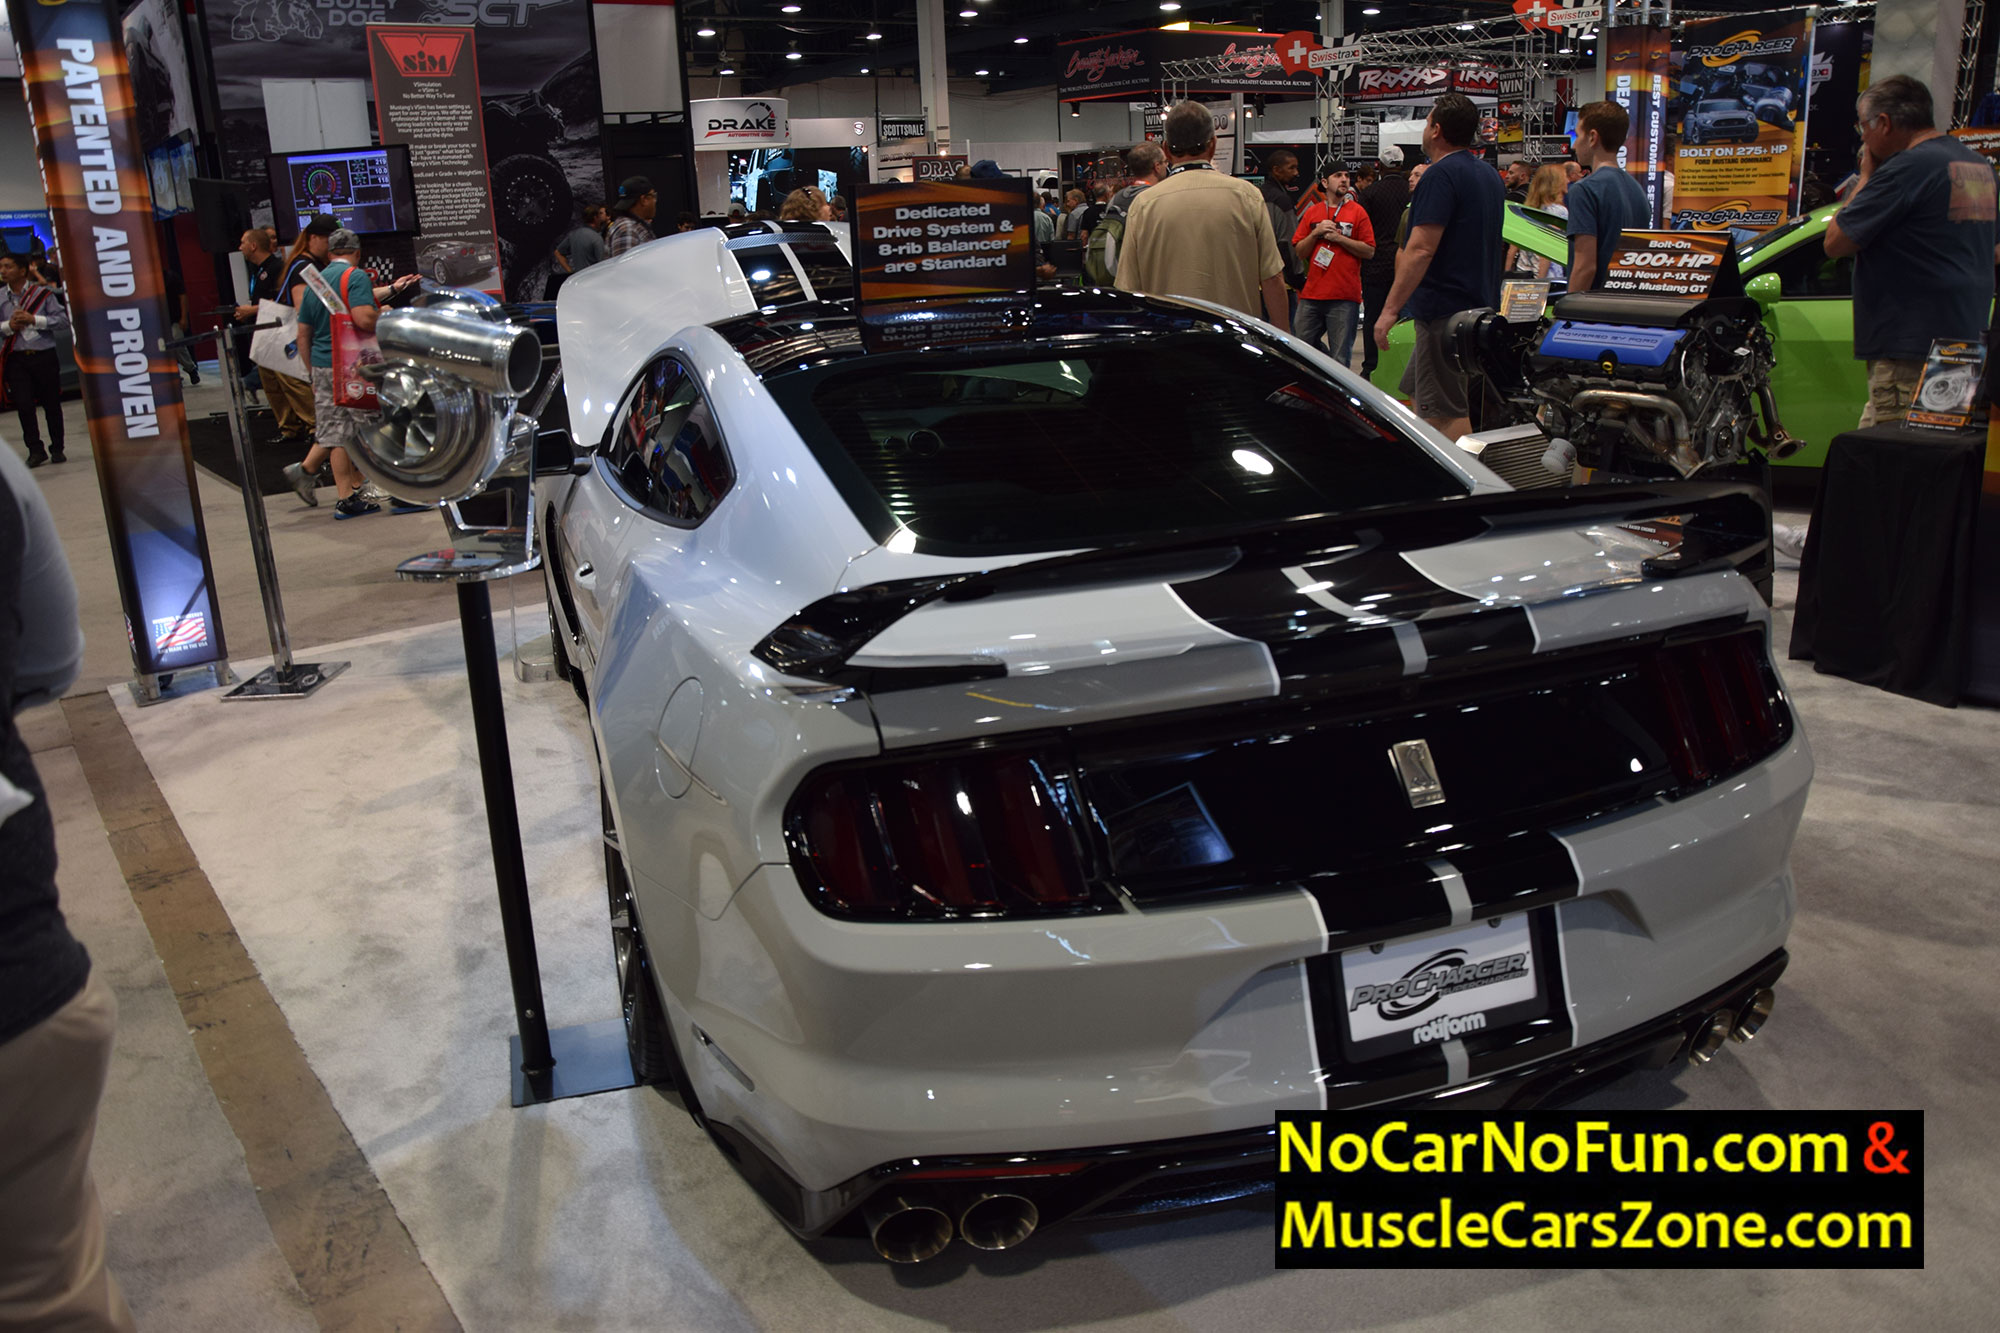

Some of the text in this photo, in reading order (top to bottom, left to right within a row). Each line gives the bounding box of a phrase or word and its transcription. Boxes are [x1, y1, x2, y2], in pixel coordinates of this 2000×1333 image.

[329, 10, 387, 26] DOG
[1550, 10, 1597, 22] Swisstrax
[1311, 50, 1356, 63] Swisstrax
[1424, 87, 1447, 95] Control
[1500, 79, 1523, 93] WIN
[708, 118, 776, 130] DRAKE
[1145, 115, 1162, 125] WIN
[883, 123, 924, 136] SCOTTSDALE
[1648, 75, 1662, 181] BEST CUSTOMER
[1680, 145, 1788, 157] BOLT ON 275+ HP
[895, 203, 990, 221] Dedicated
[873, 220, 1013, 239] Drive System &
[56, 38, 160, 439] PATENTED AND PROVEN
[1649, 240, 1691, 249] Bolt-On
[878, 239, 1011, 256] 8-rib Balancer
[884, 254, 1007, 273] are Standard
[1619, 252, 1715, 268] 300+ HP
[1609, 269, 1711, 281] With New P-1X For
[1604, 281, 1707, 294] 2015+ Mustang GT
[1557, 331, 1608, 340] POWERED
[1439, 968, 1529, 998] SUPERCHARGERS
[1413, 1012, 1486, 1044] rotiform
